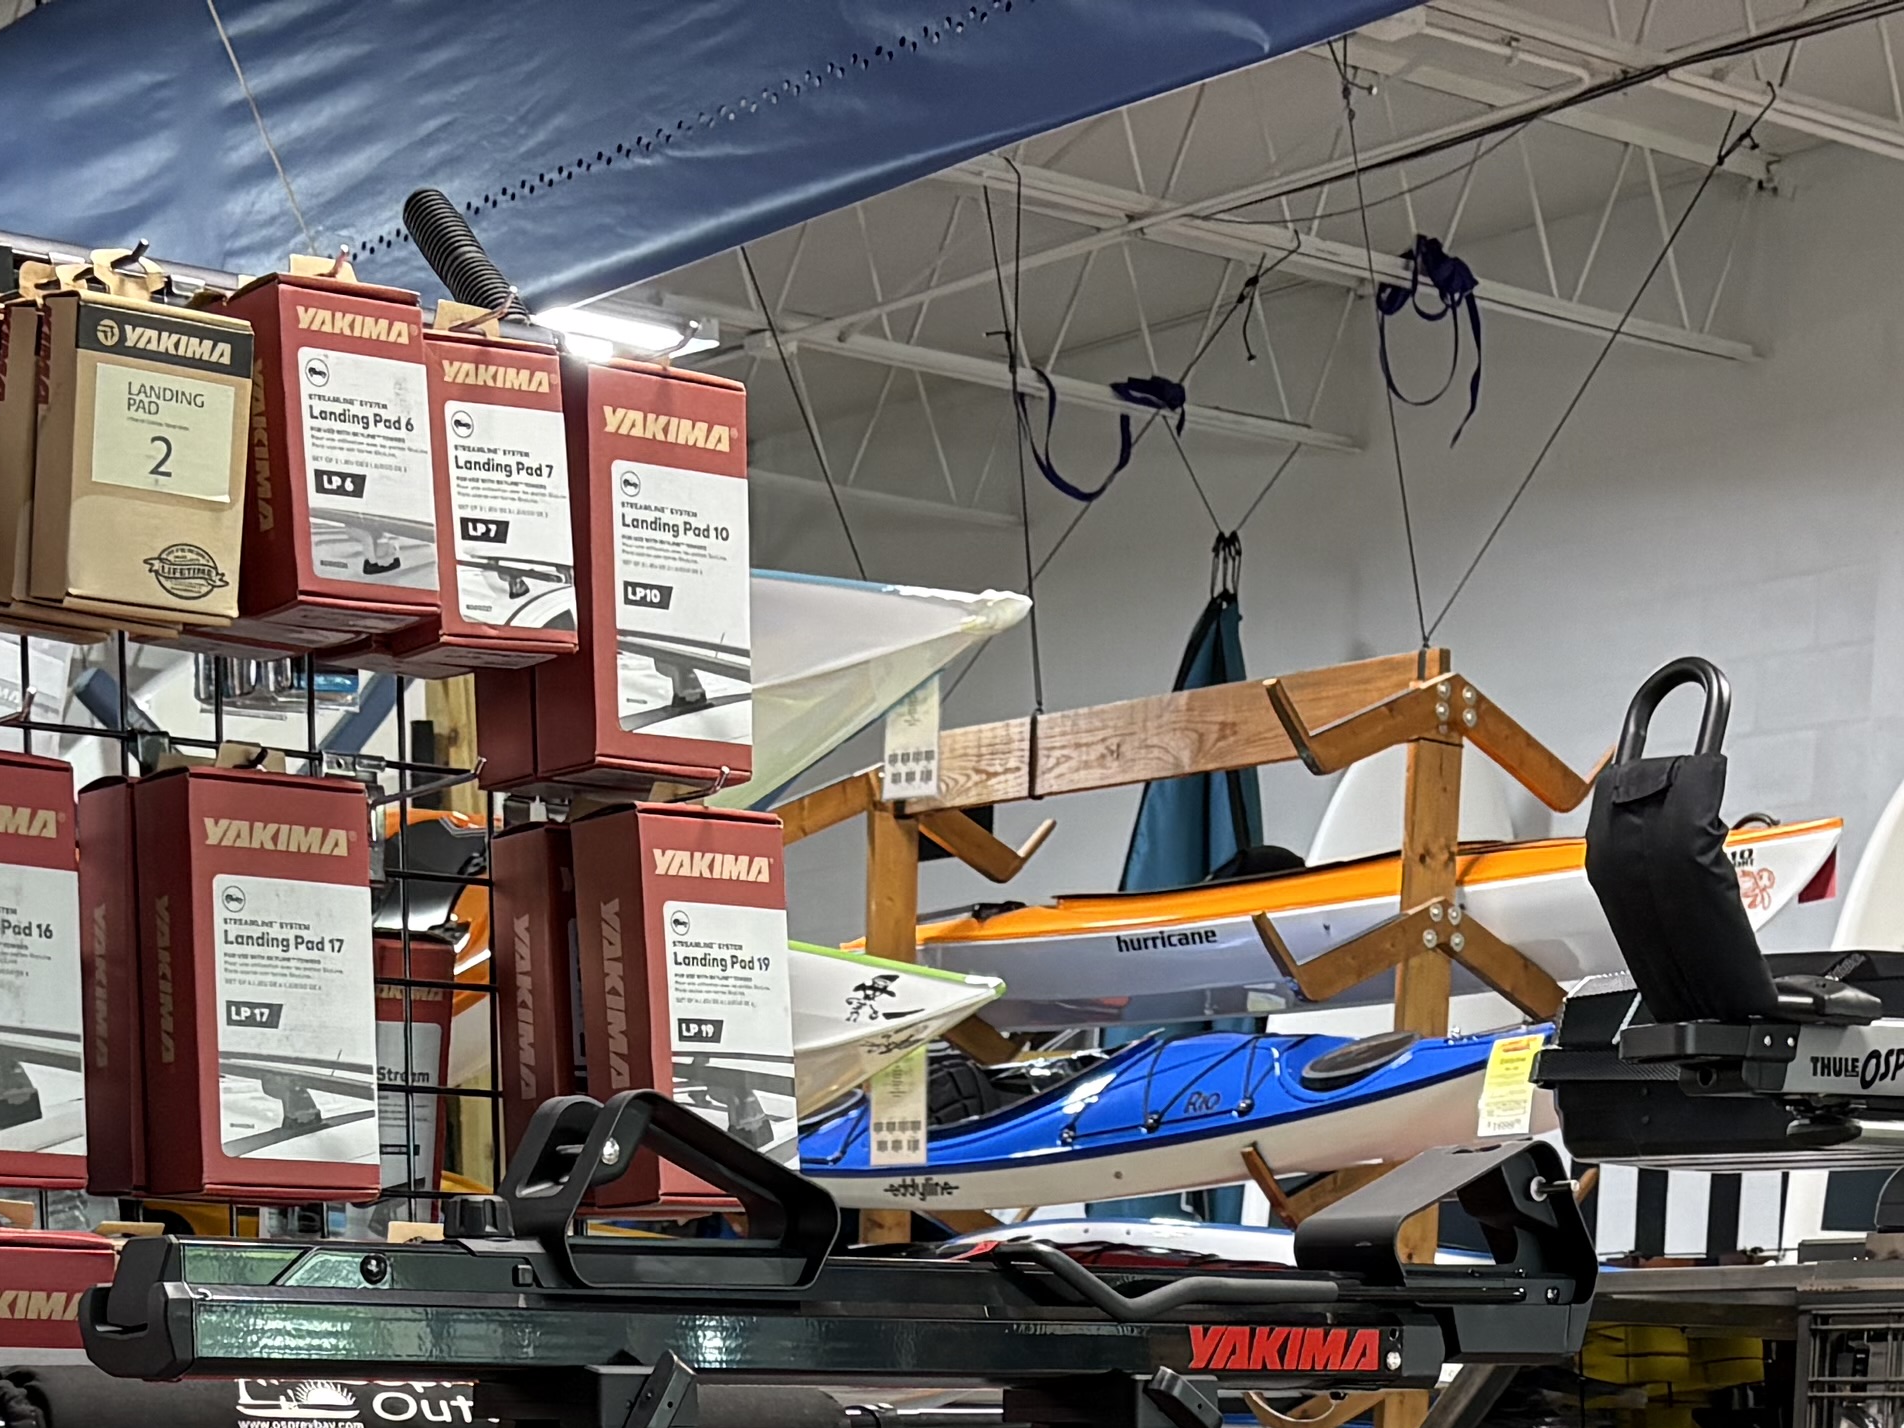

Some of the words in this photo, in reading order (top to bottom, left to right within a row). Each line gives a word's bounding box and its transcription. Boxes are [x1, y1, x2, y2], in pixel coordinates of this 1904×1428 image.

[296, 305, 410, 345] YAKIMA
[124, 324, 232, 366] YAKIMA
[127, 381, 205, 409] LANDING
[127, 397, 160, 416] PAD
[309, 406, 369, 431] Landing
[373, 413, 401, 431] Pad
[405, 416, 414, 432] 6
[603, 405, 733, 453] YAKIMA
[148, 436, 173, 478] 2
[323, 474, 340, 490] LP
[343, 478, 354, 492] 6
[621, 513, 680, 539] Landing
[683, 521, 710, 539] Pad
[714, 525, 730, 542] 10
[160, 562, 215, 580] LIFETIME
[653, 849, 771, 884] YAKIMA
[1, 918, 33, 938] Pad
[36, 923, 53, 940] 16
[1116, 929, 1218, 953] hurricane
[673, 952, 727, 972] Landing
[730, 955, 755, 971] Pad
[757, 957, 770, 972] 19
[601, 898, 630, 1090] YAKIMA
[1810, 1054, 1860, 1078] THULE
[1187, 1325, 1381, 1371] YAKIMA
